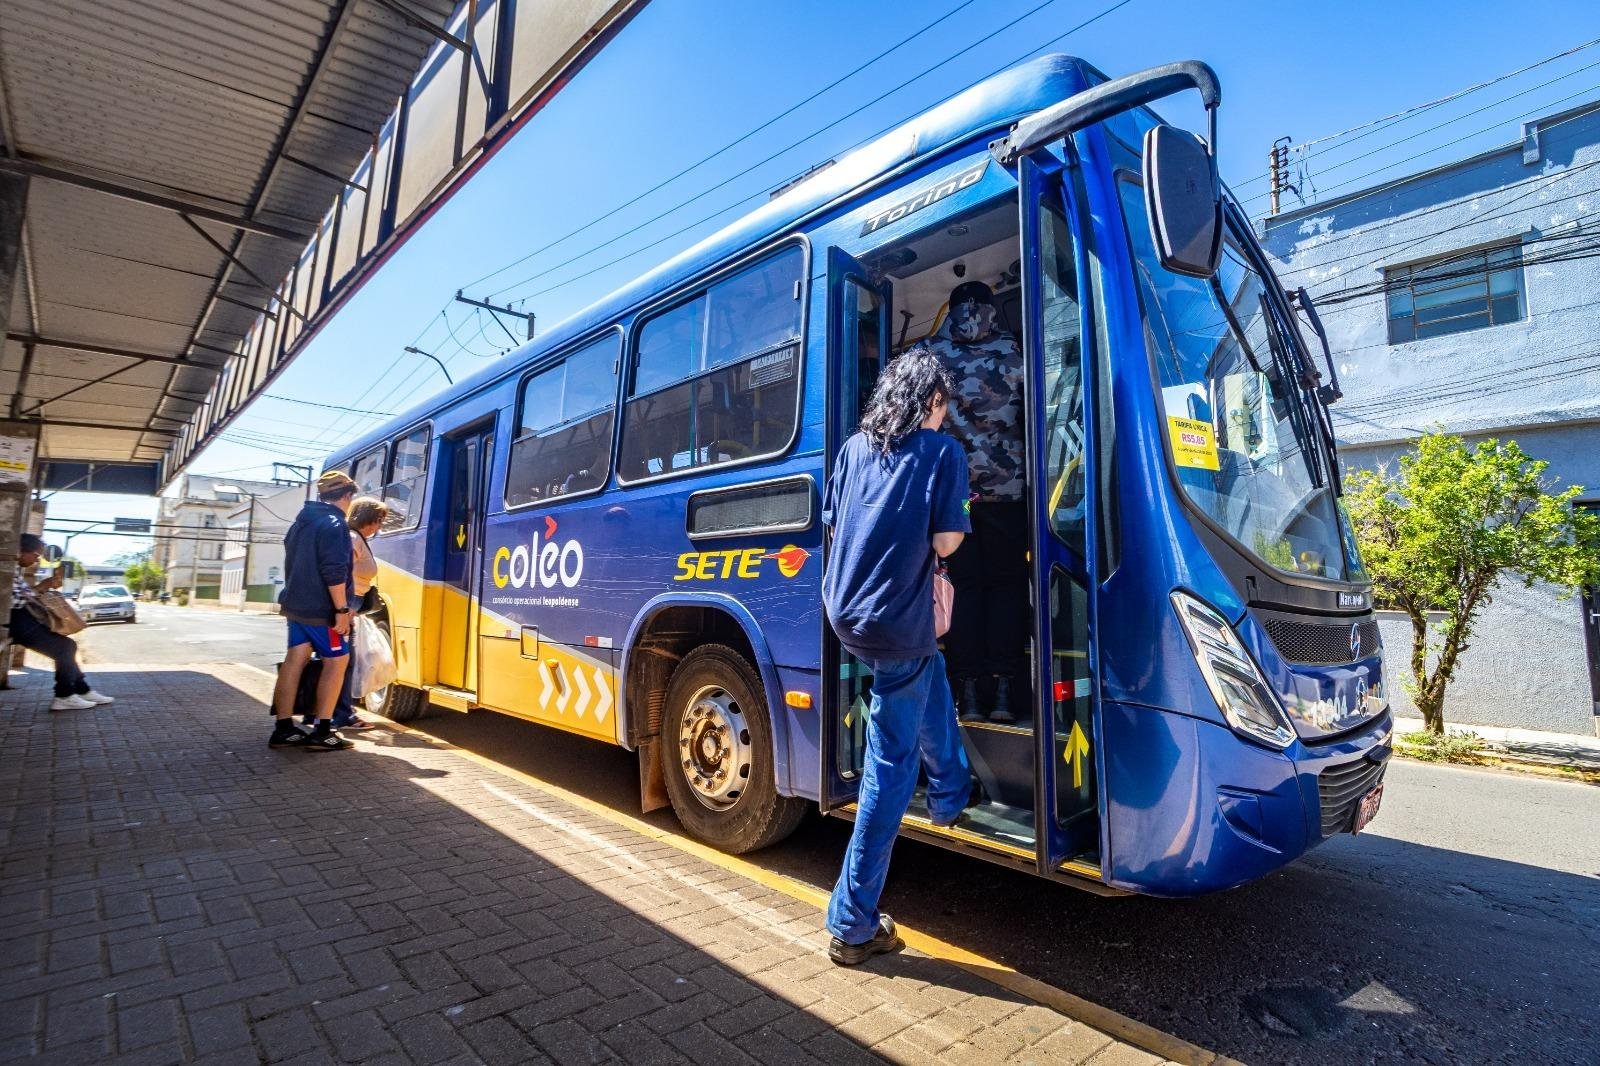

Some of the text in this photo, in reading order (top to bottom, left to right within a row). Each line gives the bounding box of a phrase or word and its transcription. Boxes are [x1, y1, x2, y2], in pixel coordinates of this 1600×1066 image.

[867, 169, 983, 231] Torino
[673, 548, 766, 581] SETE
[513, 596, 542, 606] operacional
[542, 595, 579, 608] leopoldense
